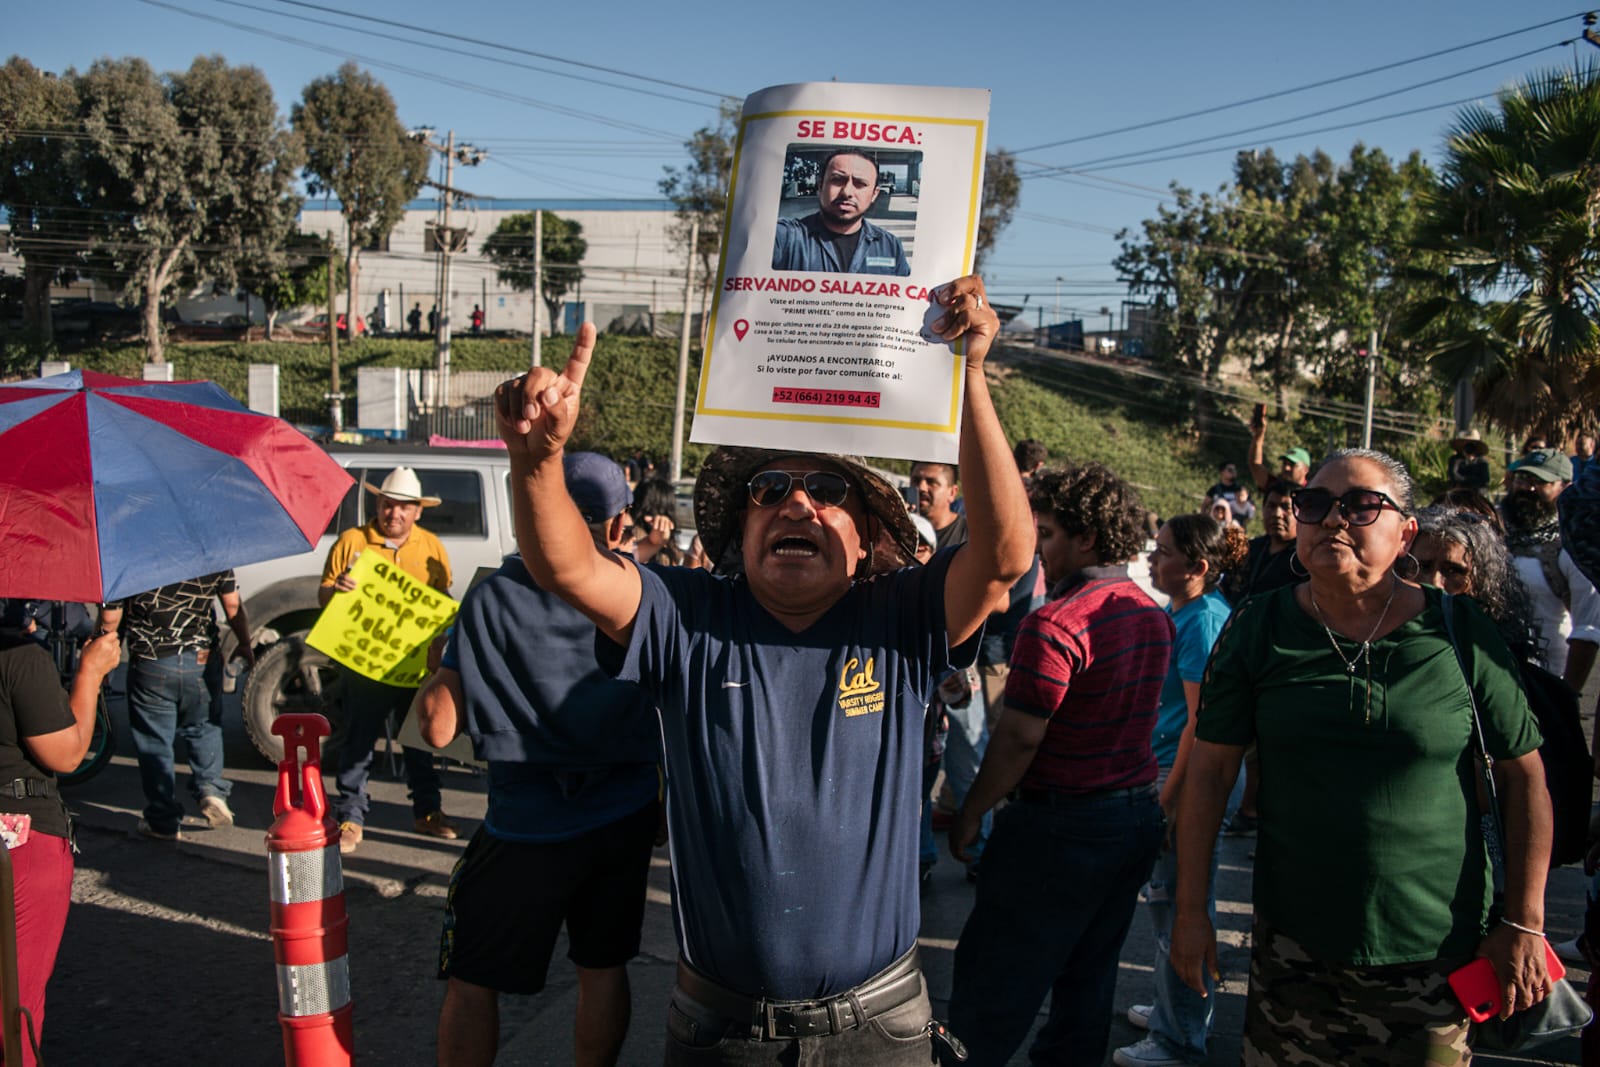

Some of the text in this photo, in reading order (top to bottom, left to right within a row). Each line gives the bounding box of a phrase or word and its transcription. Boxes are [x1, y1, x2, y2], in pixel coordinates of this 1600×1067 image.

[797, 120, 922, 144] SE BUSCA:
[724, 277, 944, 304] SERVANDO SALAZAR CAN
[821, 299, 854, 307] uniforme
[873, 303, 905, 311] empresa
[880, 342, 898, 350] Santa
[899, 345, 916, 353] Anita
[767, 354, 895, 368] ¡AYUDANOS A ENCONTRARLO!
[757, 365, 765, 373] Si
[766, 365, 775, 373] lo
[776, 366, 797, 374] viste
[798, 368, 813, 376] por
[815, 367, 838, 376] favor
[773, 391, 878, 405] +52 (664) 219 94 45
[839, 657, 880, 696] Cal
